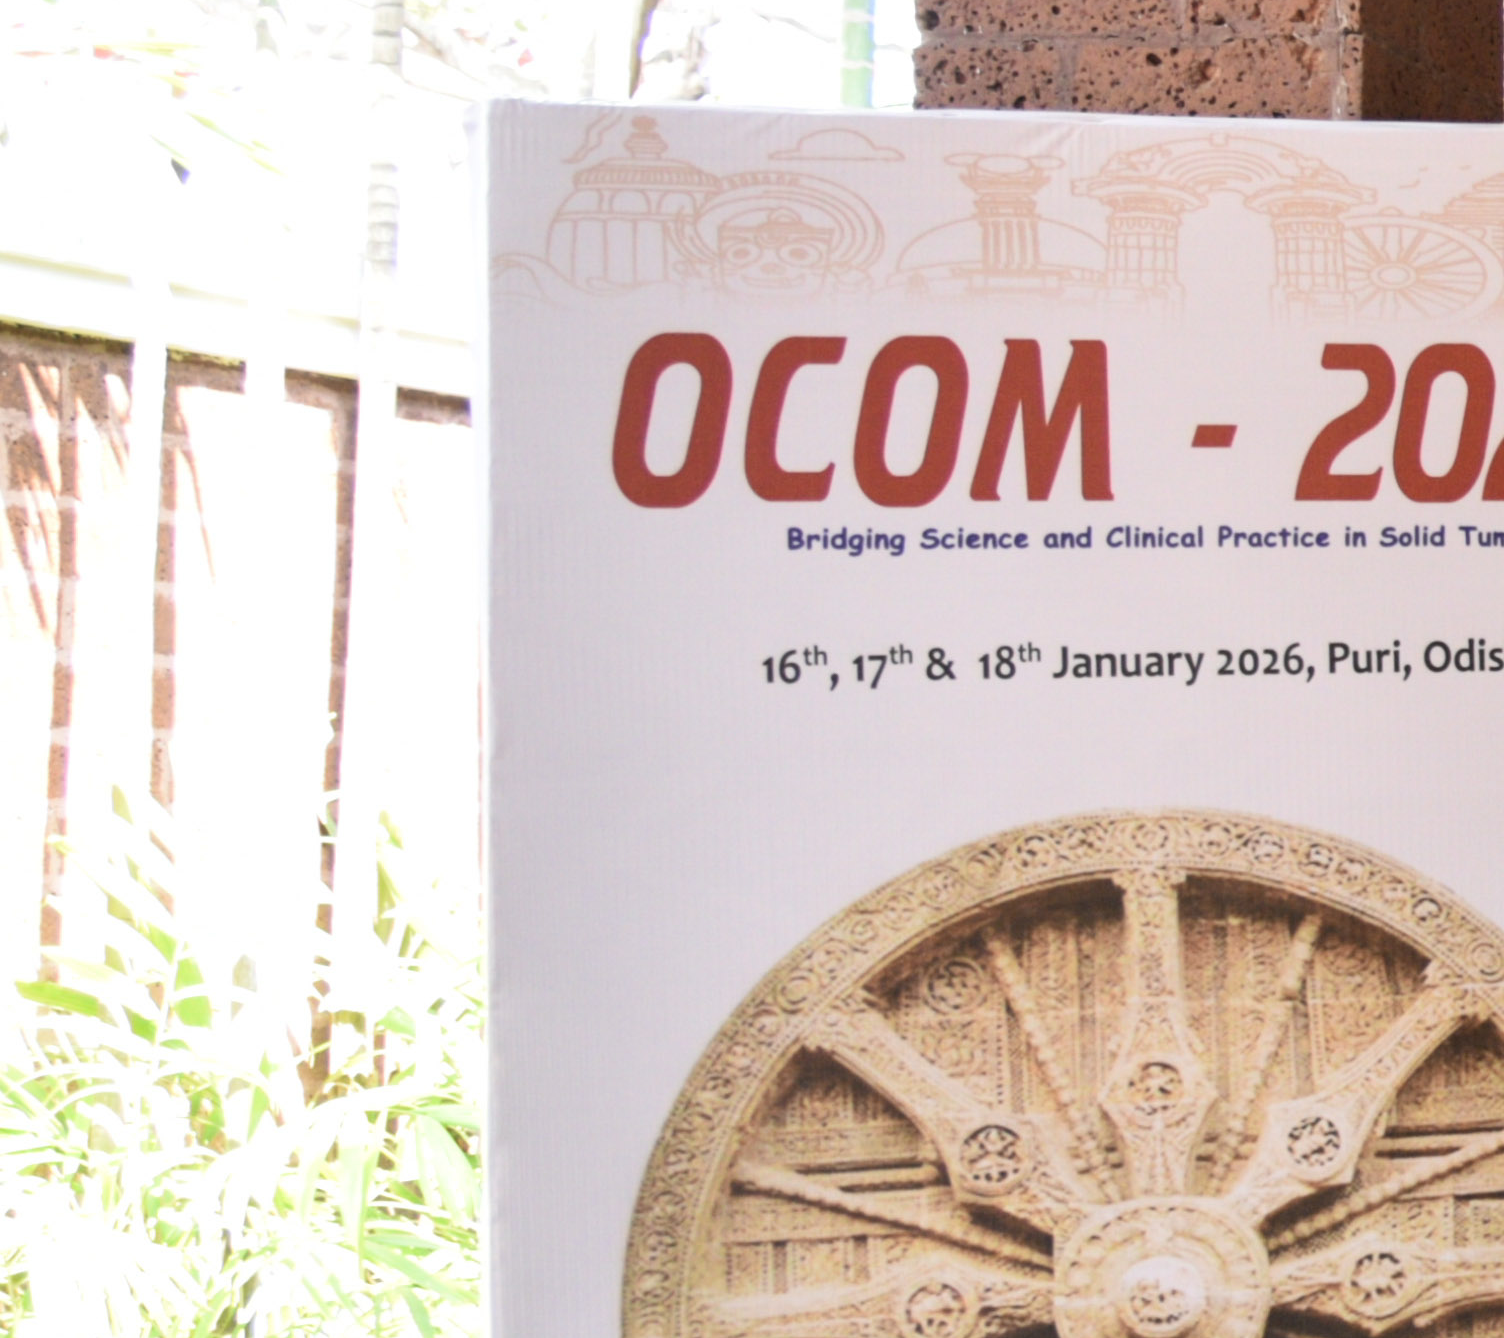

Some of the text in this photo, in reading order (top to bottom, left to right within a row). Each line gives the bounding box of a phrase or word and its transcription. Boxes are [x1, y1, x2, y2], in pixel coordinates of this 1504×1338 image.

[612, 332, 1114, 508] OCOM
[1192, 425, 1237, 448] -
[787, 527, 905, 557] Bridging
[920, 528, 1028, 549] Science
[1044, 526, 1092, 548] and
[1106, 525, 1203, 548] Clinical
[1218, 525, 1330, 548] Practice
[1345, 527, 1366, 547] in
[1380, 525, 1445, 547] Solid
[853, 644, 913, 689] 17th
[926, 648, 956, 680] &
[979, 642, 1041, 679] 18th
[1053, 646, 1204, 686] January
[1218, 643, 1315, 682] 2026,
[1329, 640, 1411, 680] Puri,
